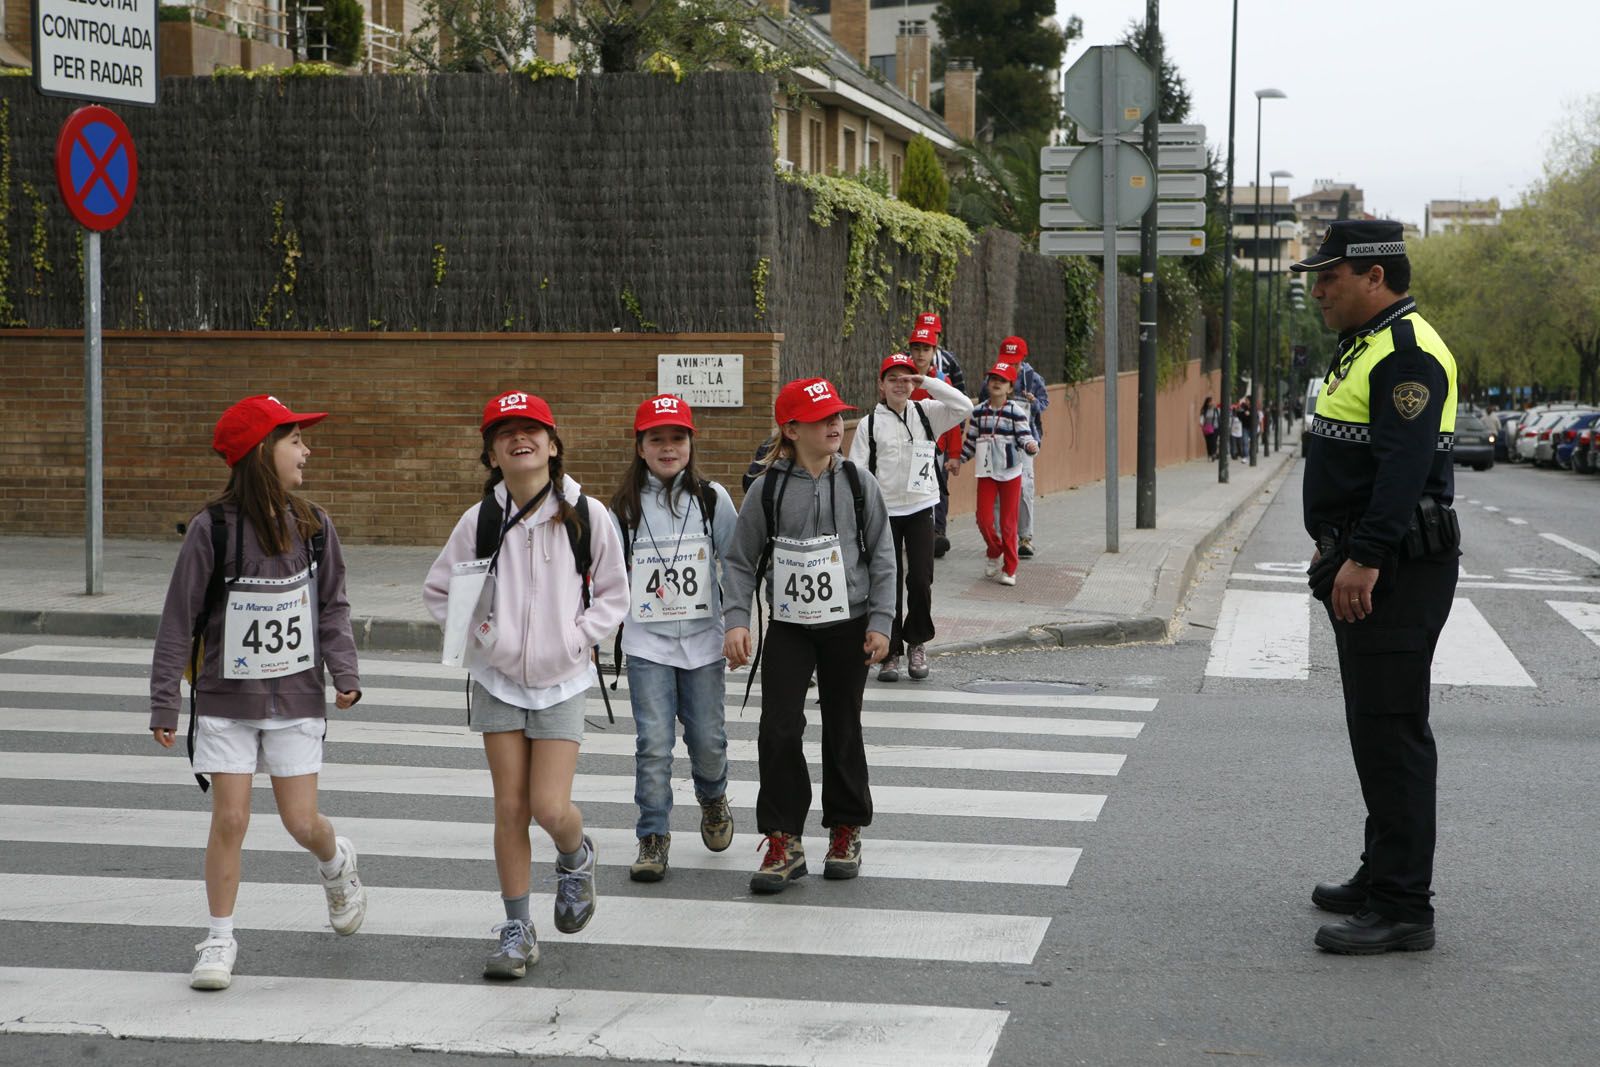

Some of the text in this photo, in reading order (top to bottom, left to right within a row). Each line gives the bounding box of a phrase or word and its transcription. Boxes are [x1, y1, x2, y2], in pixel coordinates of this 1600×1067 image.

[42, 14, 153, 51] CONTROLADA
[54, 54, 143, 87] PER RADAR
[1350, 246, 1375, 255] POLICIA
[676, 357, 724, 368] AVINA
[676, 371, 723, 383] DEL LA
[803, 381, 829, 397] TOT
[498, 392, 528, 407] TOT
[652, 397, 679, 409] TOT
[645, 566, 698, 599] 438
[784, 571, 833, 604] 438
[242, 615, 302, 654] 435
